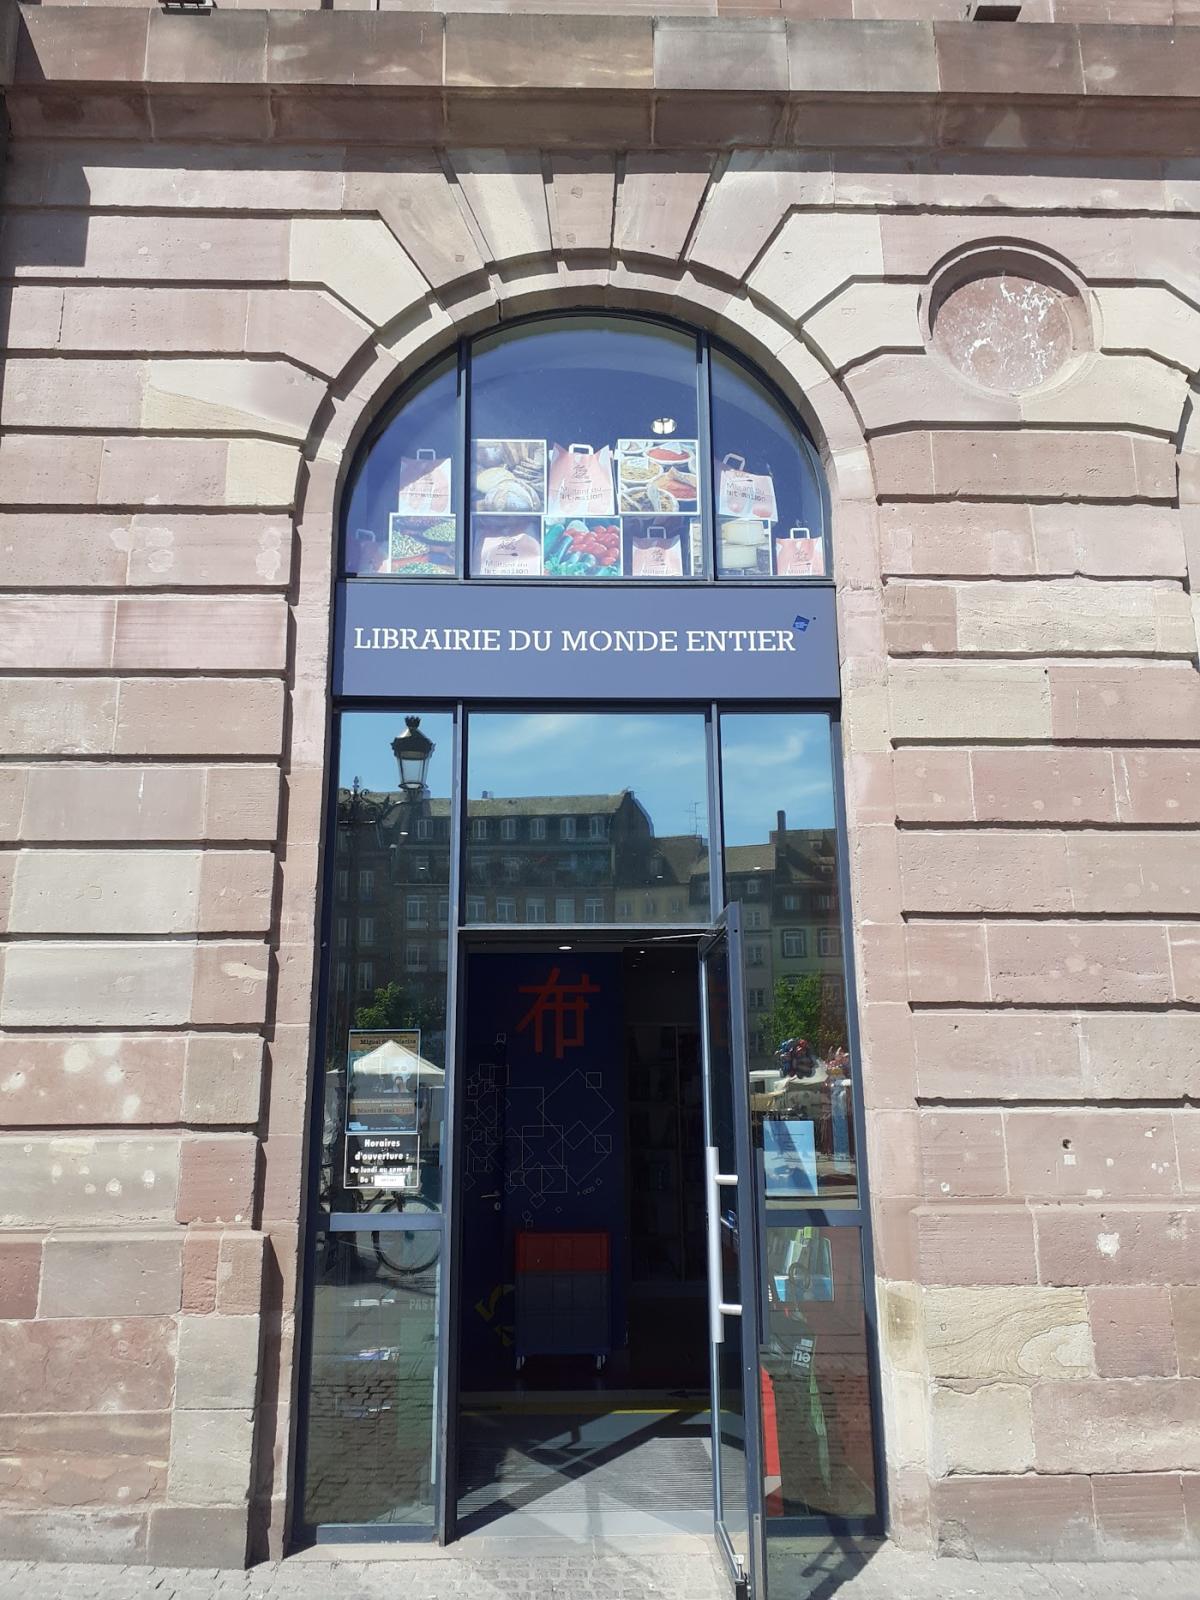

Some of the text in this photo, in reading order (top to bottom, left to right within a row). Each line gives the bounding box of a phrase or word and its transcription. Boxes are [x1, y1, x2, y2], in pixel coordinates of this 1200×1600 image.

[354, 627, 796, 652] LIBRAIRIE DU MONDE ENTIER
[364, 1138, 401, 1148] Horaires
[354, 1151, 404, 1161] d'ouverture
[360, 1165, 378, 1174] lundi
[389, 1165, 413, 1174] samedi
